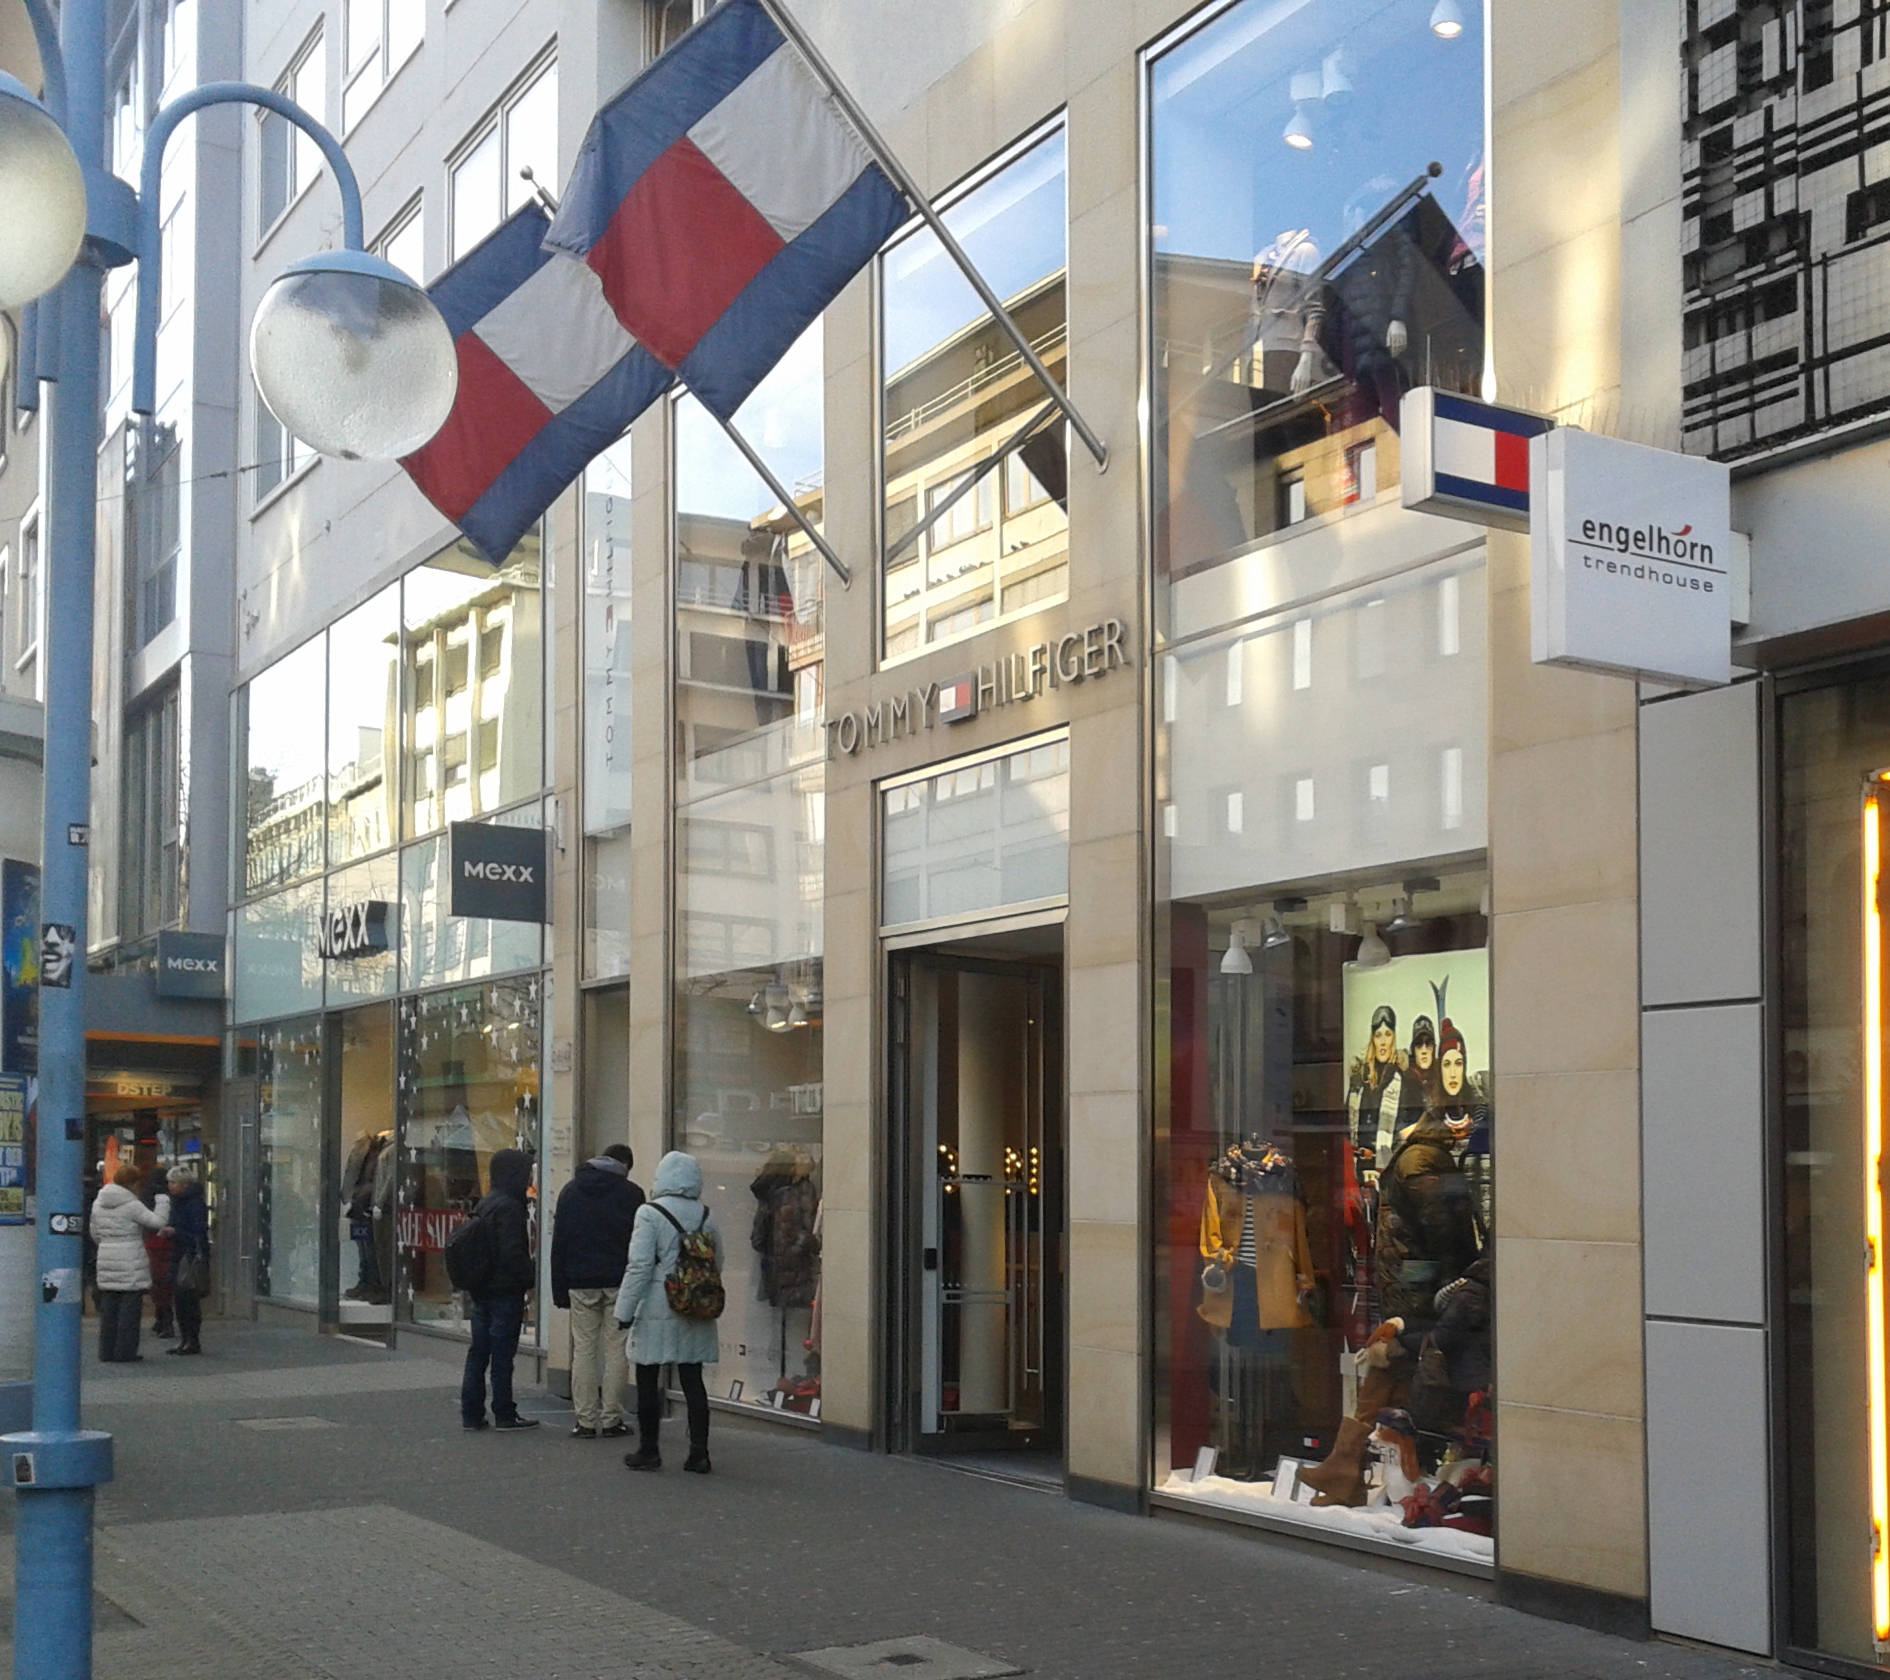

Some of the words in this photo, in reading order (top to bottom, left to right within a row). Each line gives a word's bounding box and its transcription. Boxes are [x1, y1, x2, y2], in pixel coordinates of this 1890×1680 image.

[1582, 519, 1713, 564] engelhorn
[1583, 555, 1714, 593] trendhouse
[821, 681, 940, 761] TOMMY
[976, 617, 1131, 712] HILFIGER
